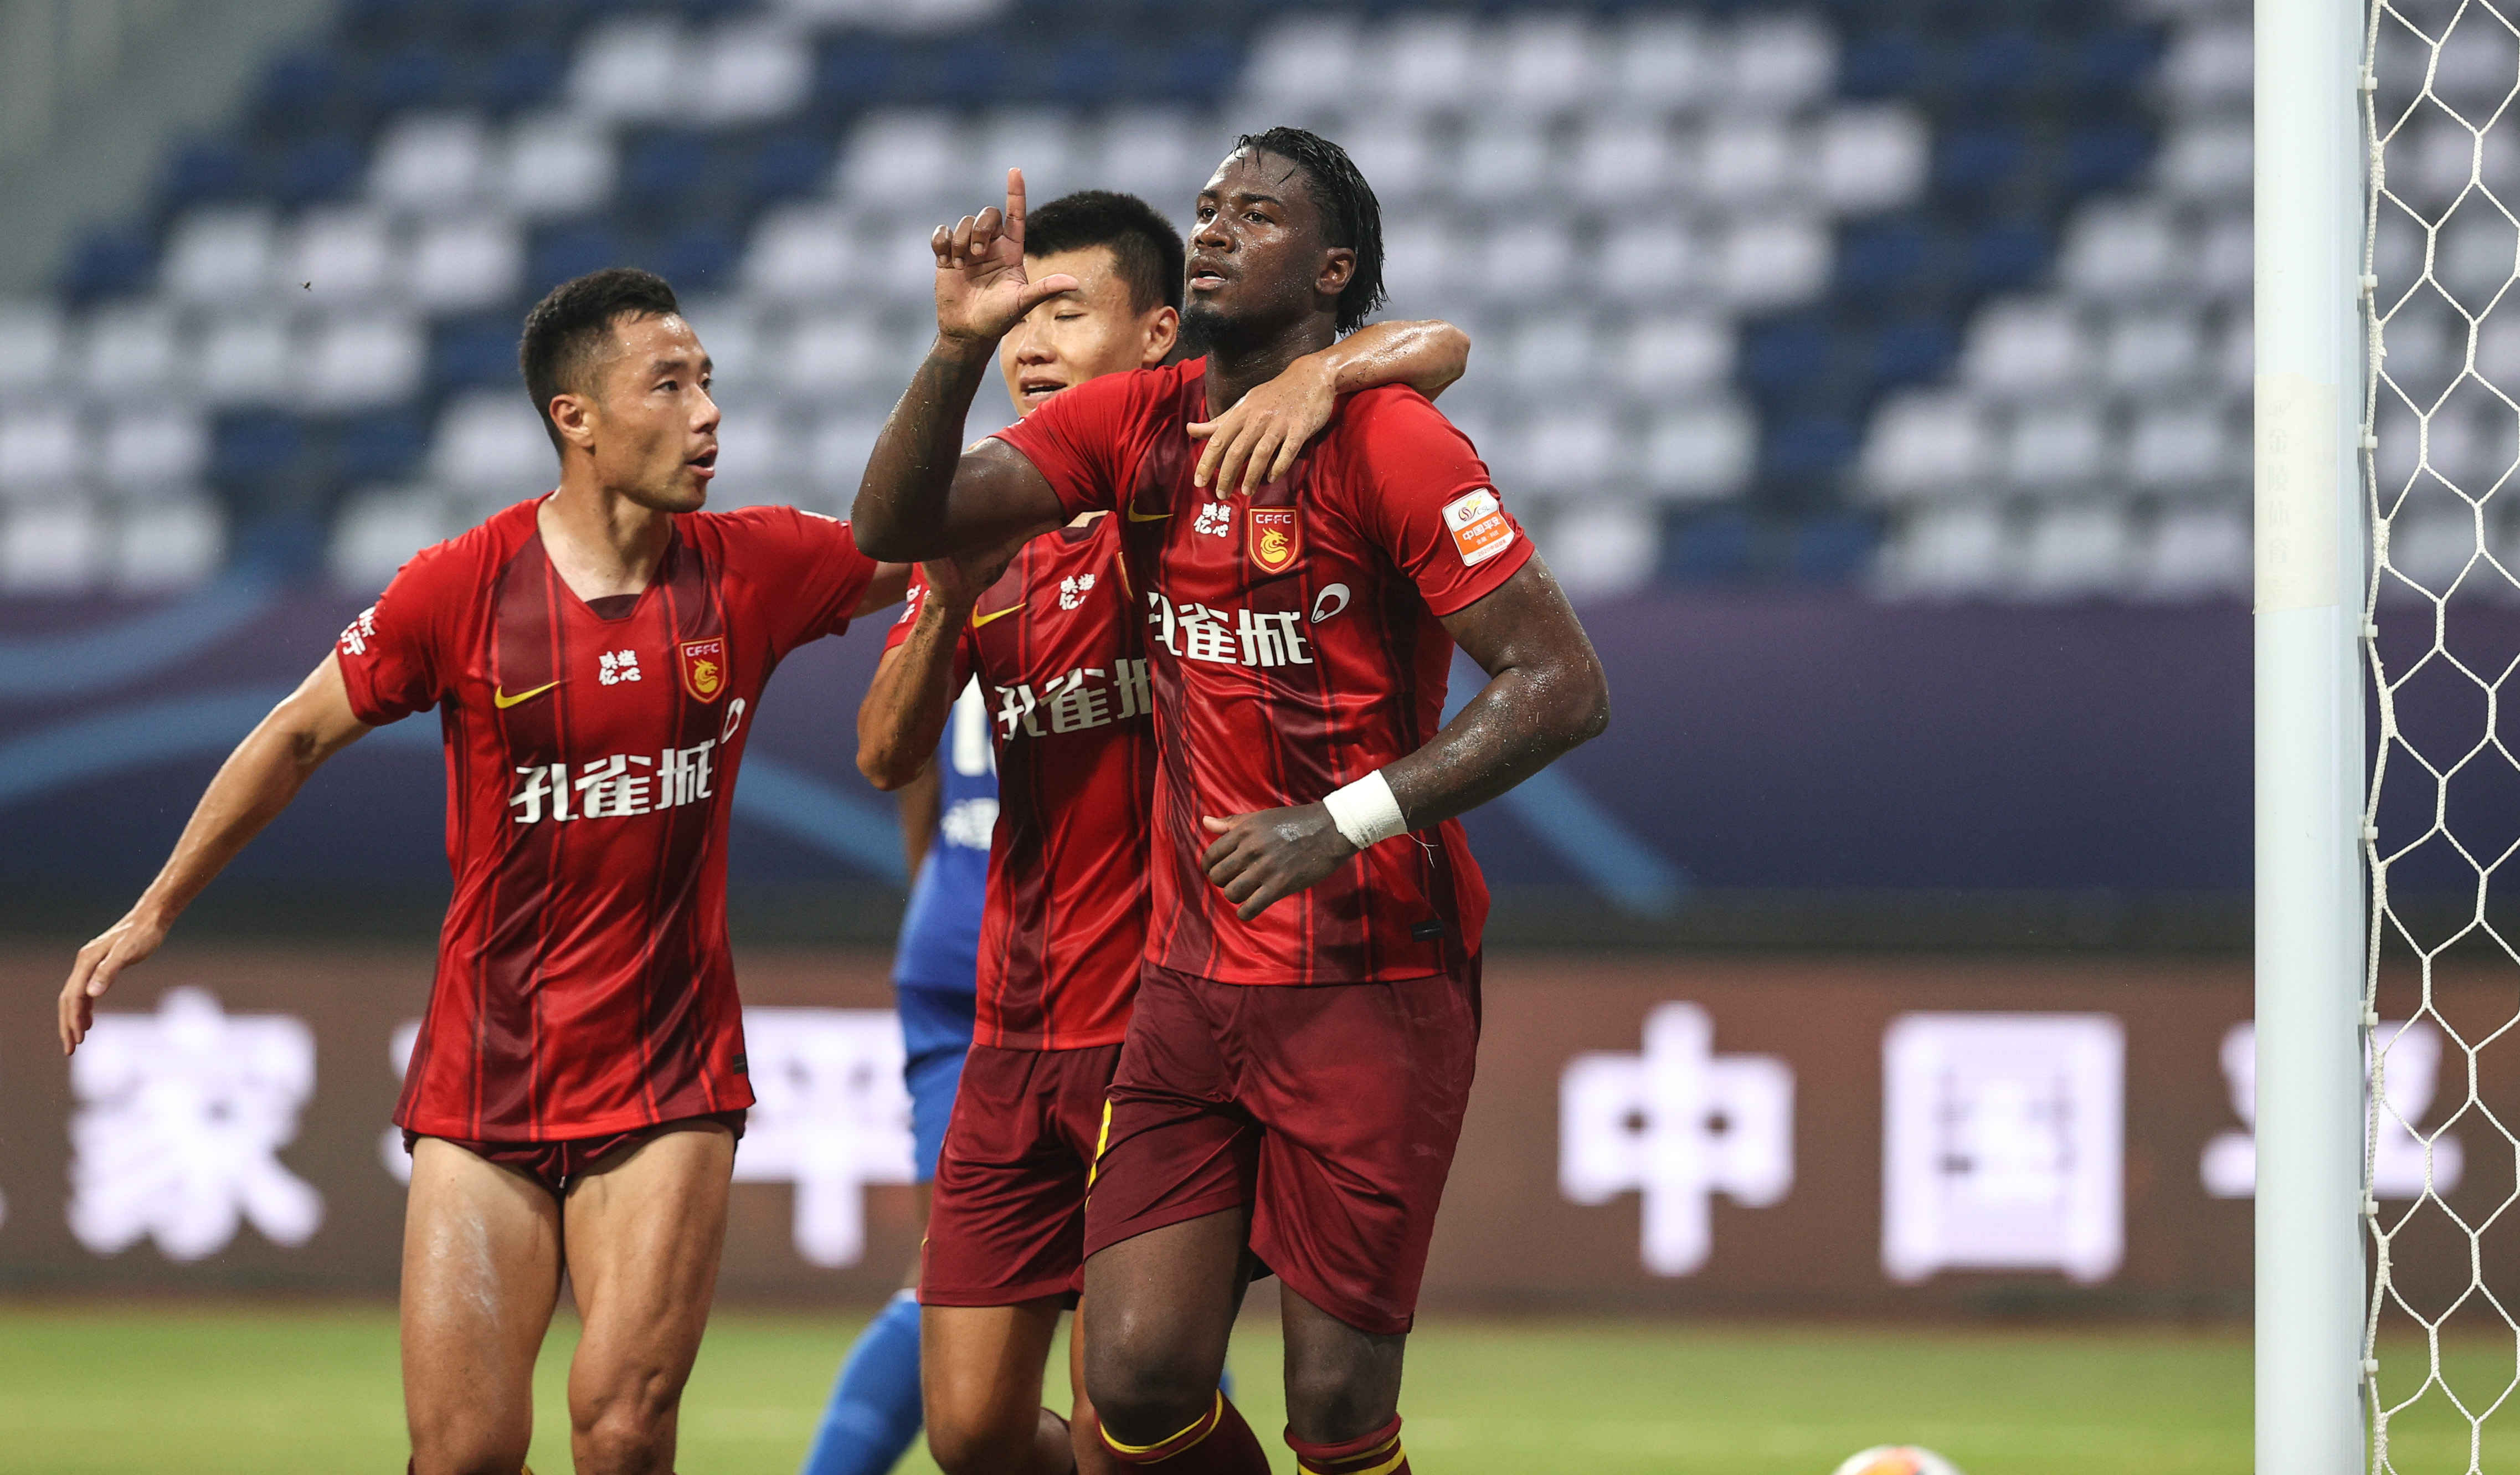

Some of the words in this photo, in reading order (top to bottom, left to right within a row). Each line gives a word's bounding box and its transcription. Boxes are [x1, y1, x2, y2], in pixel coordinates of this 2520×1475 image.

[1477, 506, 1490, 515] CSL
[1256, 514, 1292, 524] CFFC
[1462, 516, 1501, 541] 中国平安
[686, 643, 720, 657] CFFC
[509, 738, 716, 824] 孔雀城
